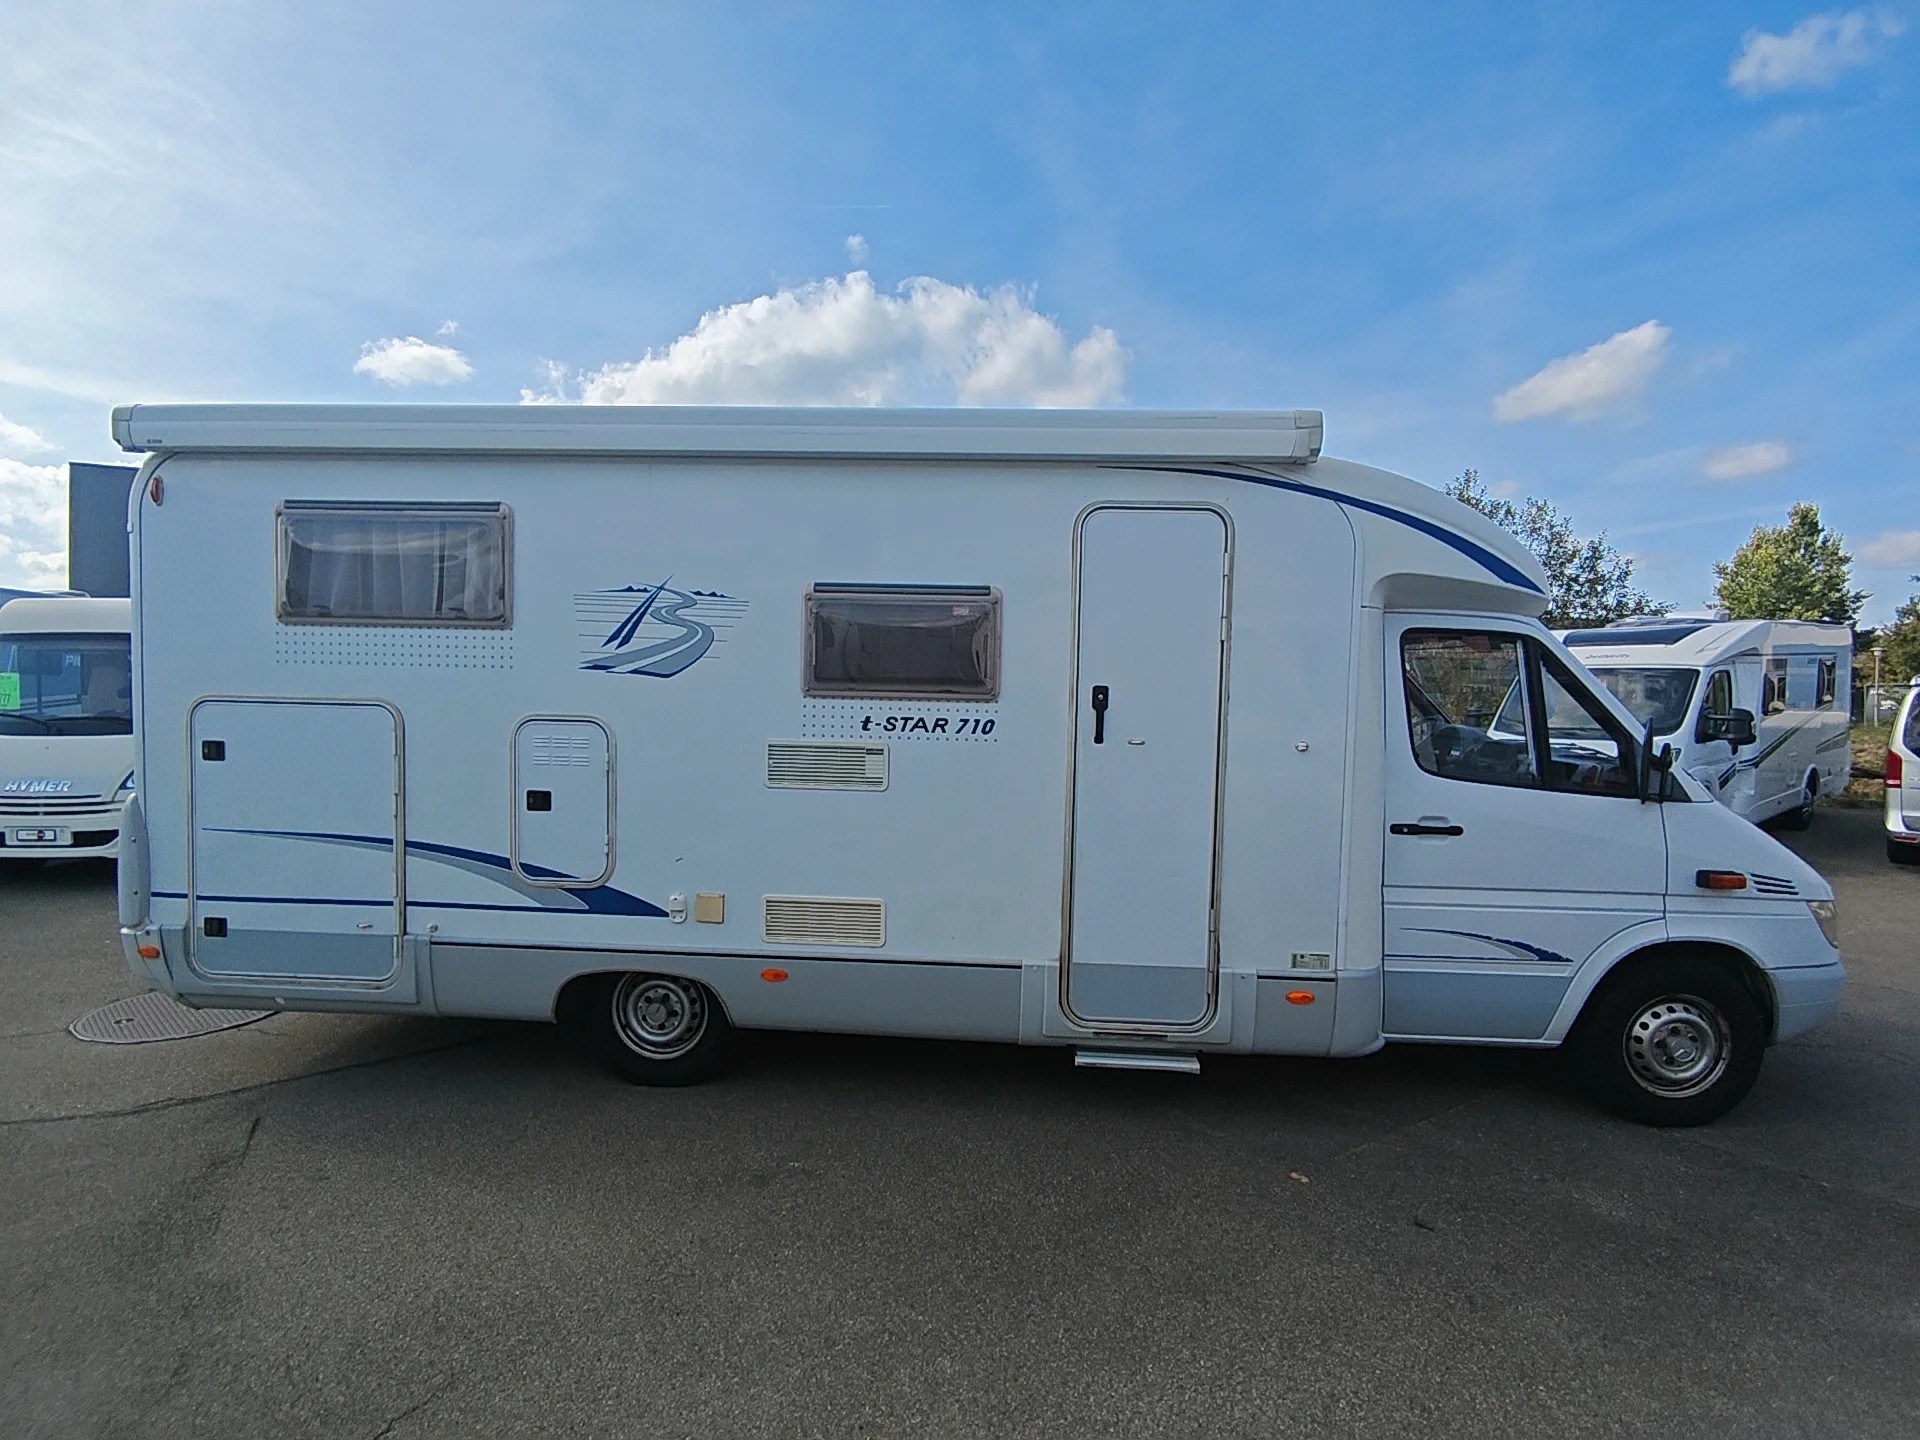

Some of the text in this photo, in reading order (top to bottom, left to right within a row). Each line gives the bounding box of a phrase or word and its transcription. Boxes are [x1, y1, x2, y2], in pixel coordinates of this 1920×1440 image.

[860, 715, 996, 735] t-STAR 710
[4, 780, 73, 793] HYMER
